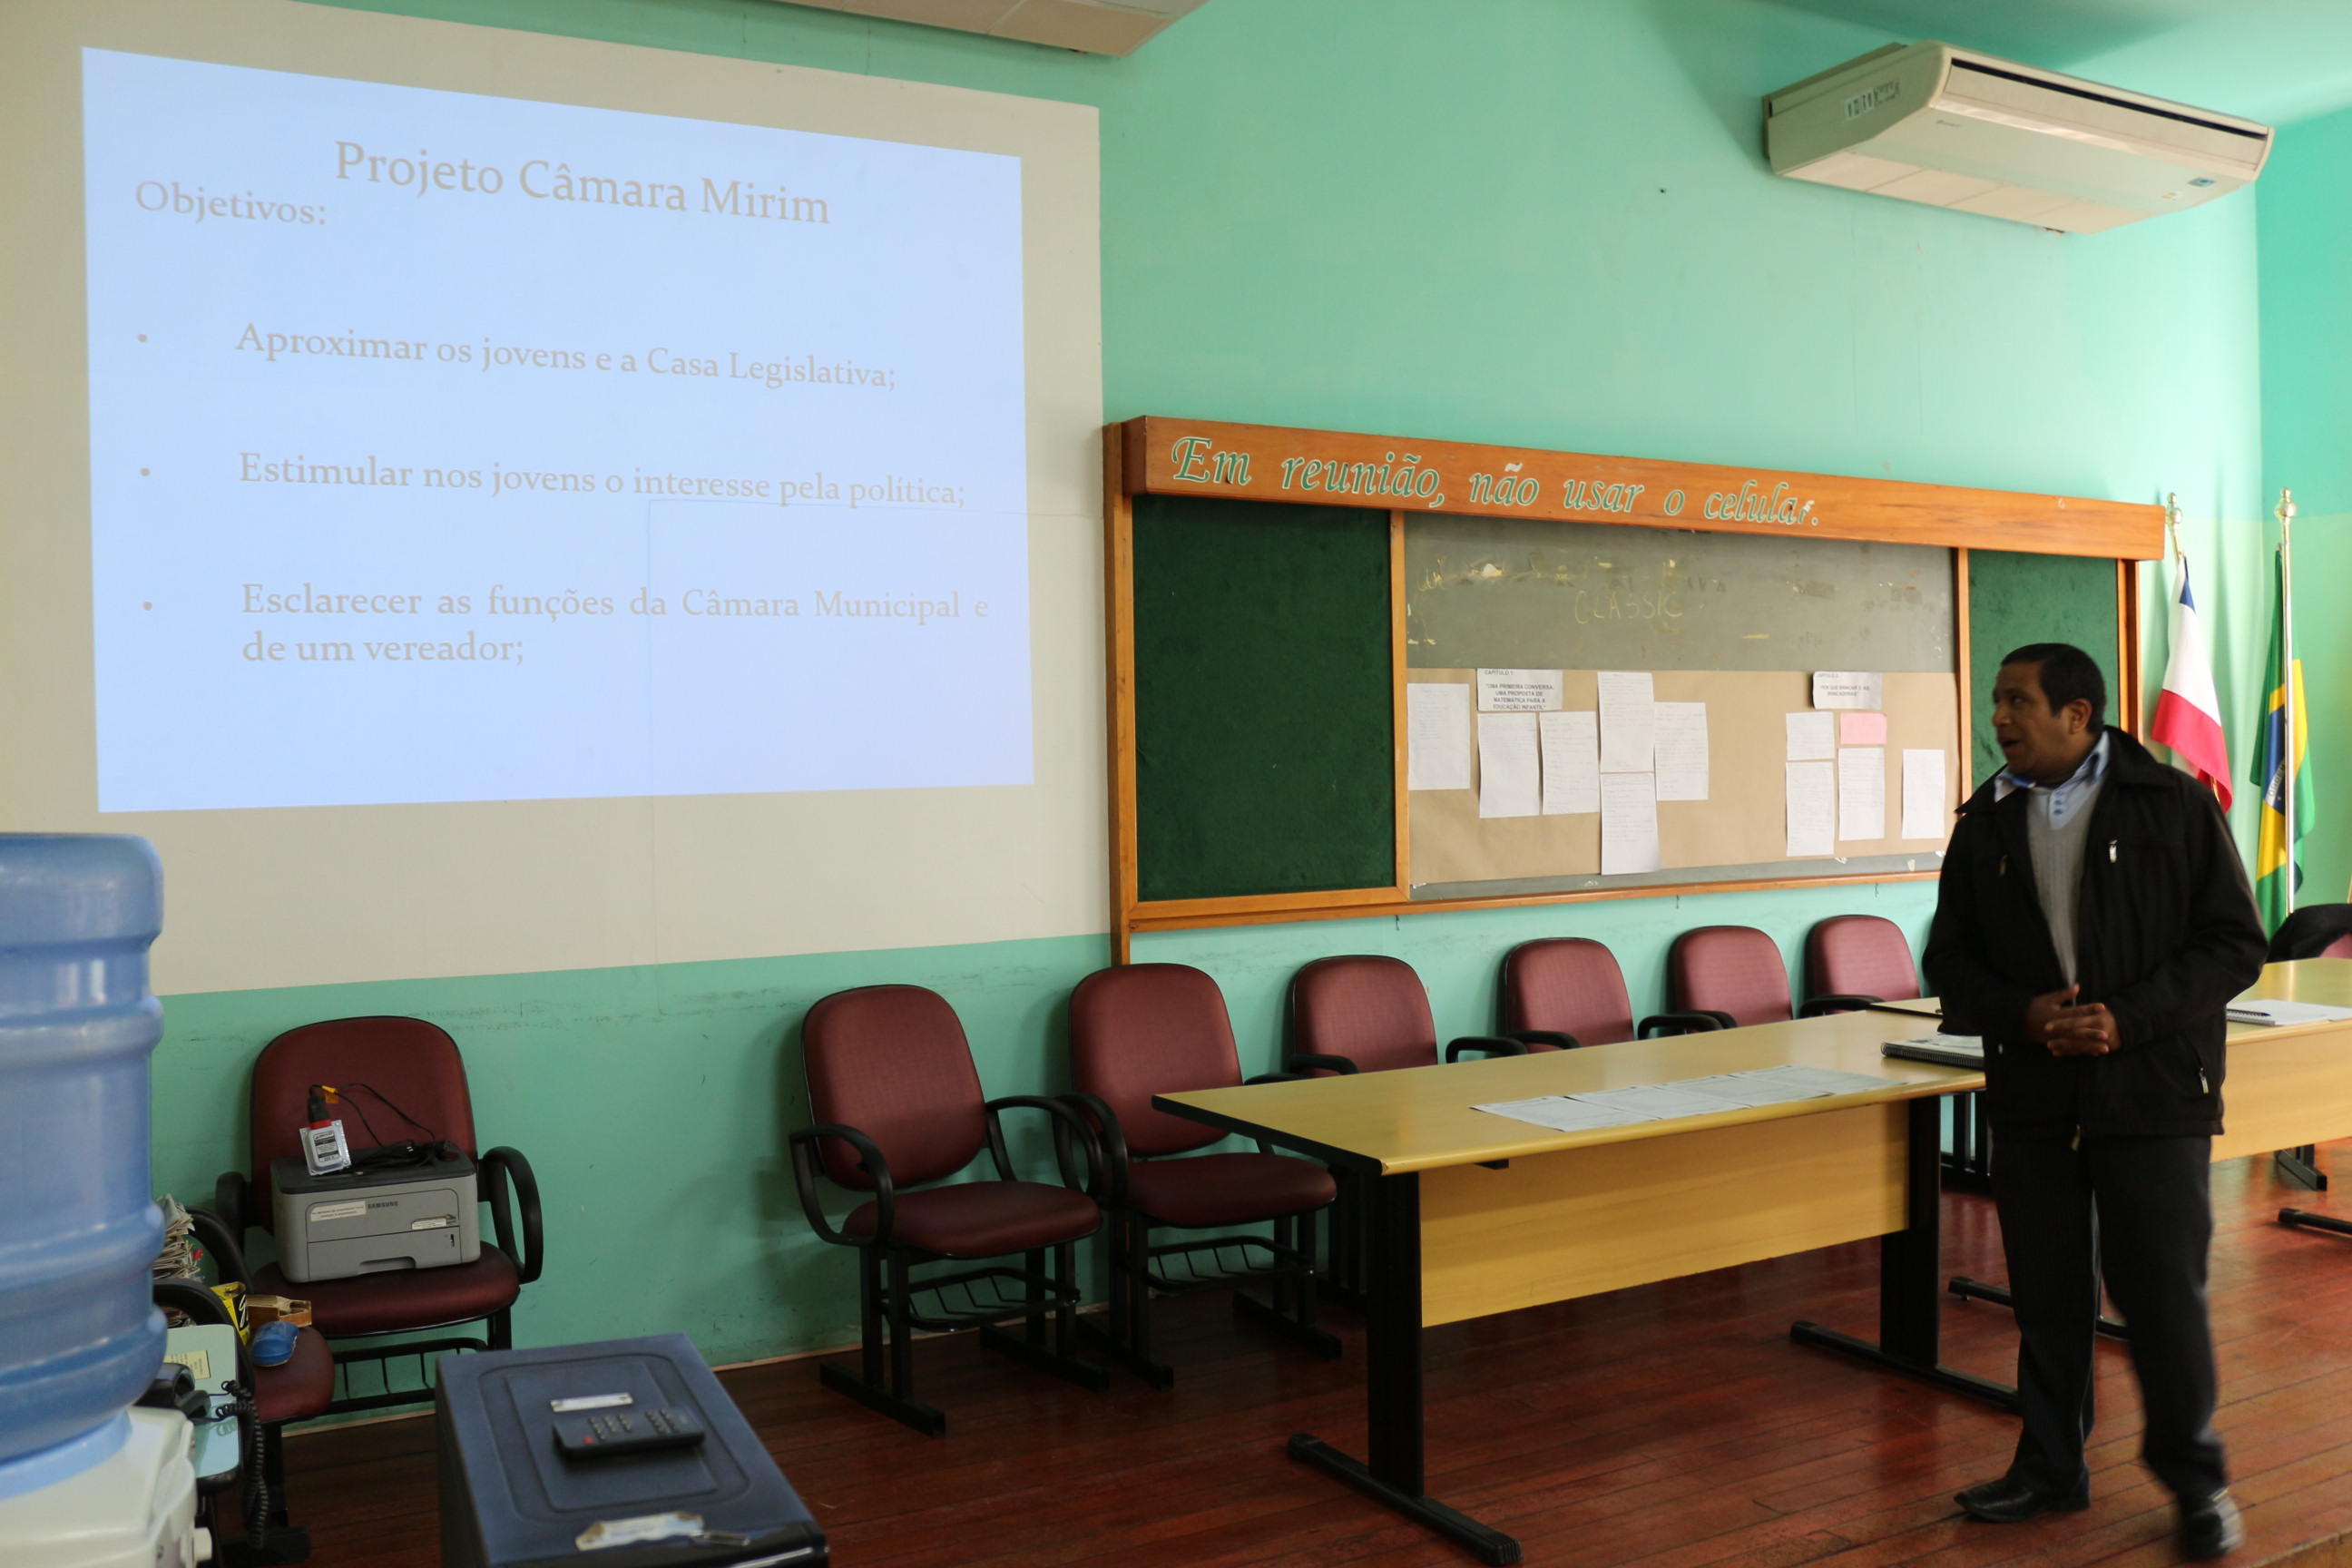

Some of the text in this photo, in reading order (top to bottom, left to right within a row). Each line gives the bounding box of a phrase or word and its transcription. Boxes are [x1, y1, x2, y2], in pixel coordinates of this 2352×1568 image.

[134, 180, 327, 226] Objetivos:
[334, 140, 831, 224] Projeto Câmara Mirim
[235, 321, 896, 392] Aproximar os jovens e a Casa Legislativa;
[239, 452, 965, 509] Estimular nos jovens o interesse pela política;
[1171, 436, 1818, 526] Em reunião, não usar o celular.
[240, 582, 989, 626] Esclarecer as funções da Câmara Municipal e
[1574, 590, 1683, 624] CLASSIC
[242, 631, 524, 665] de um vereador;
[368, 1200, 398, 1210] SAMSUNG
